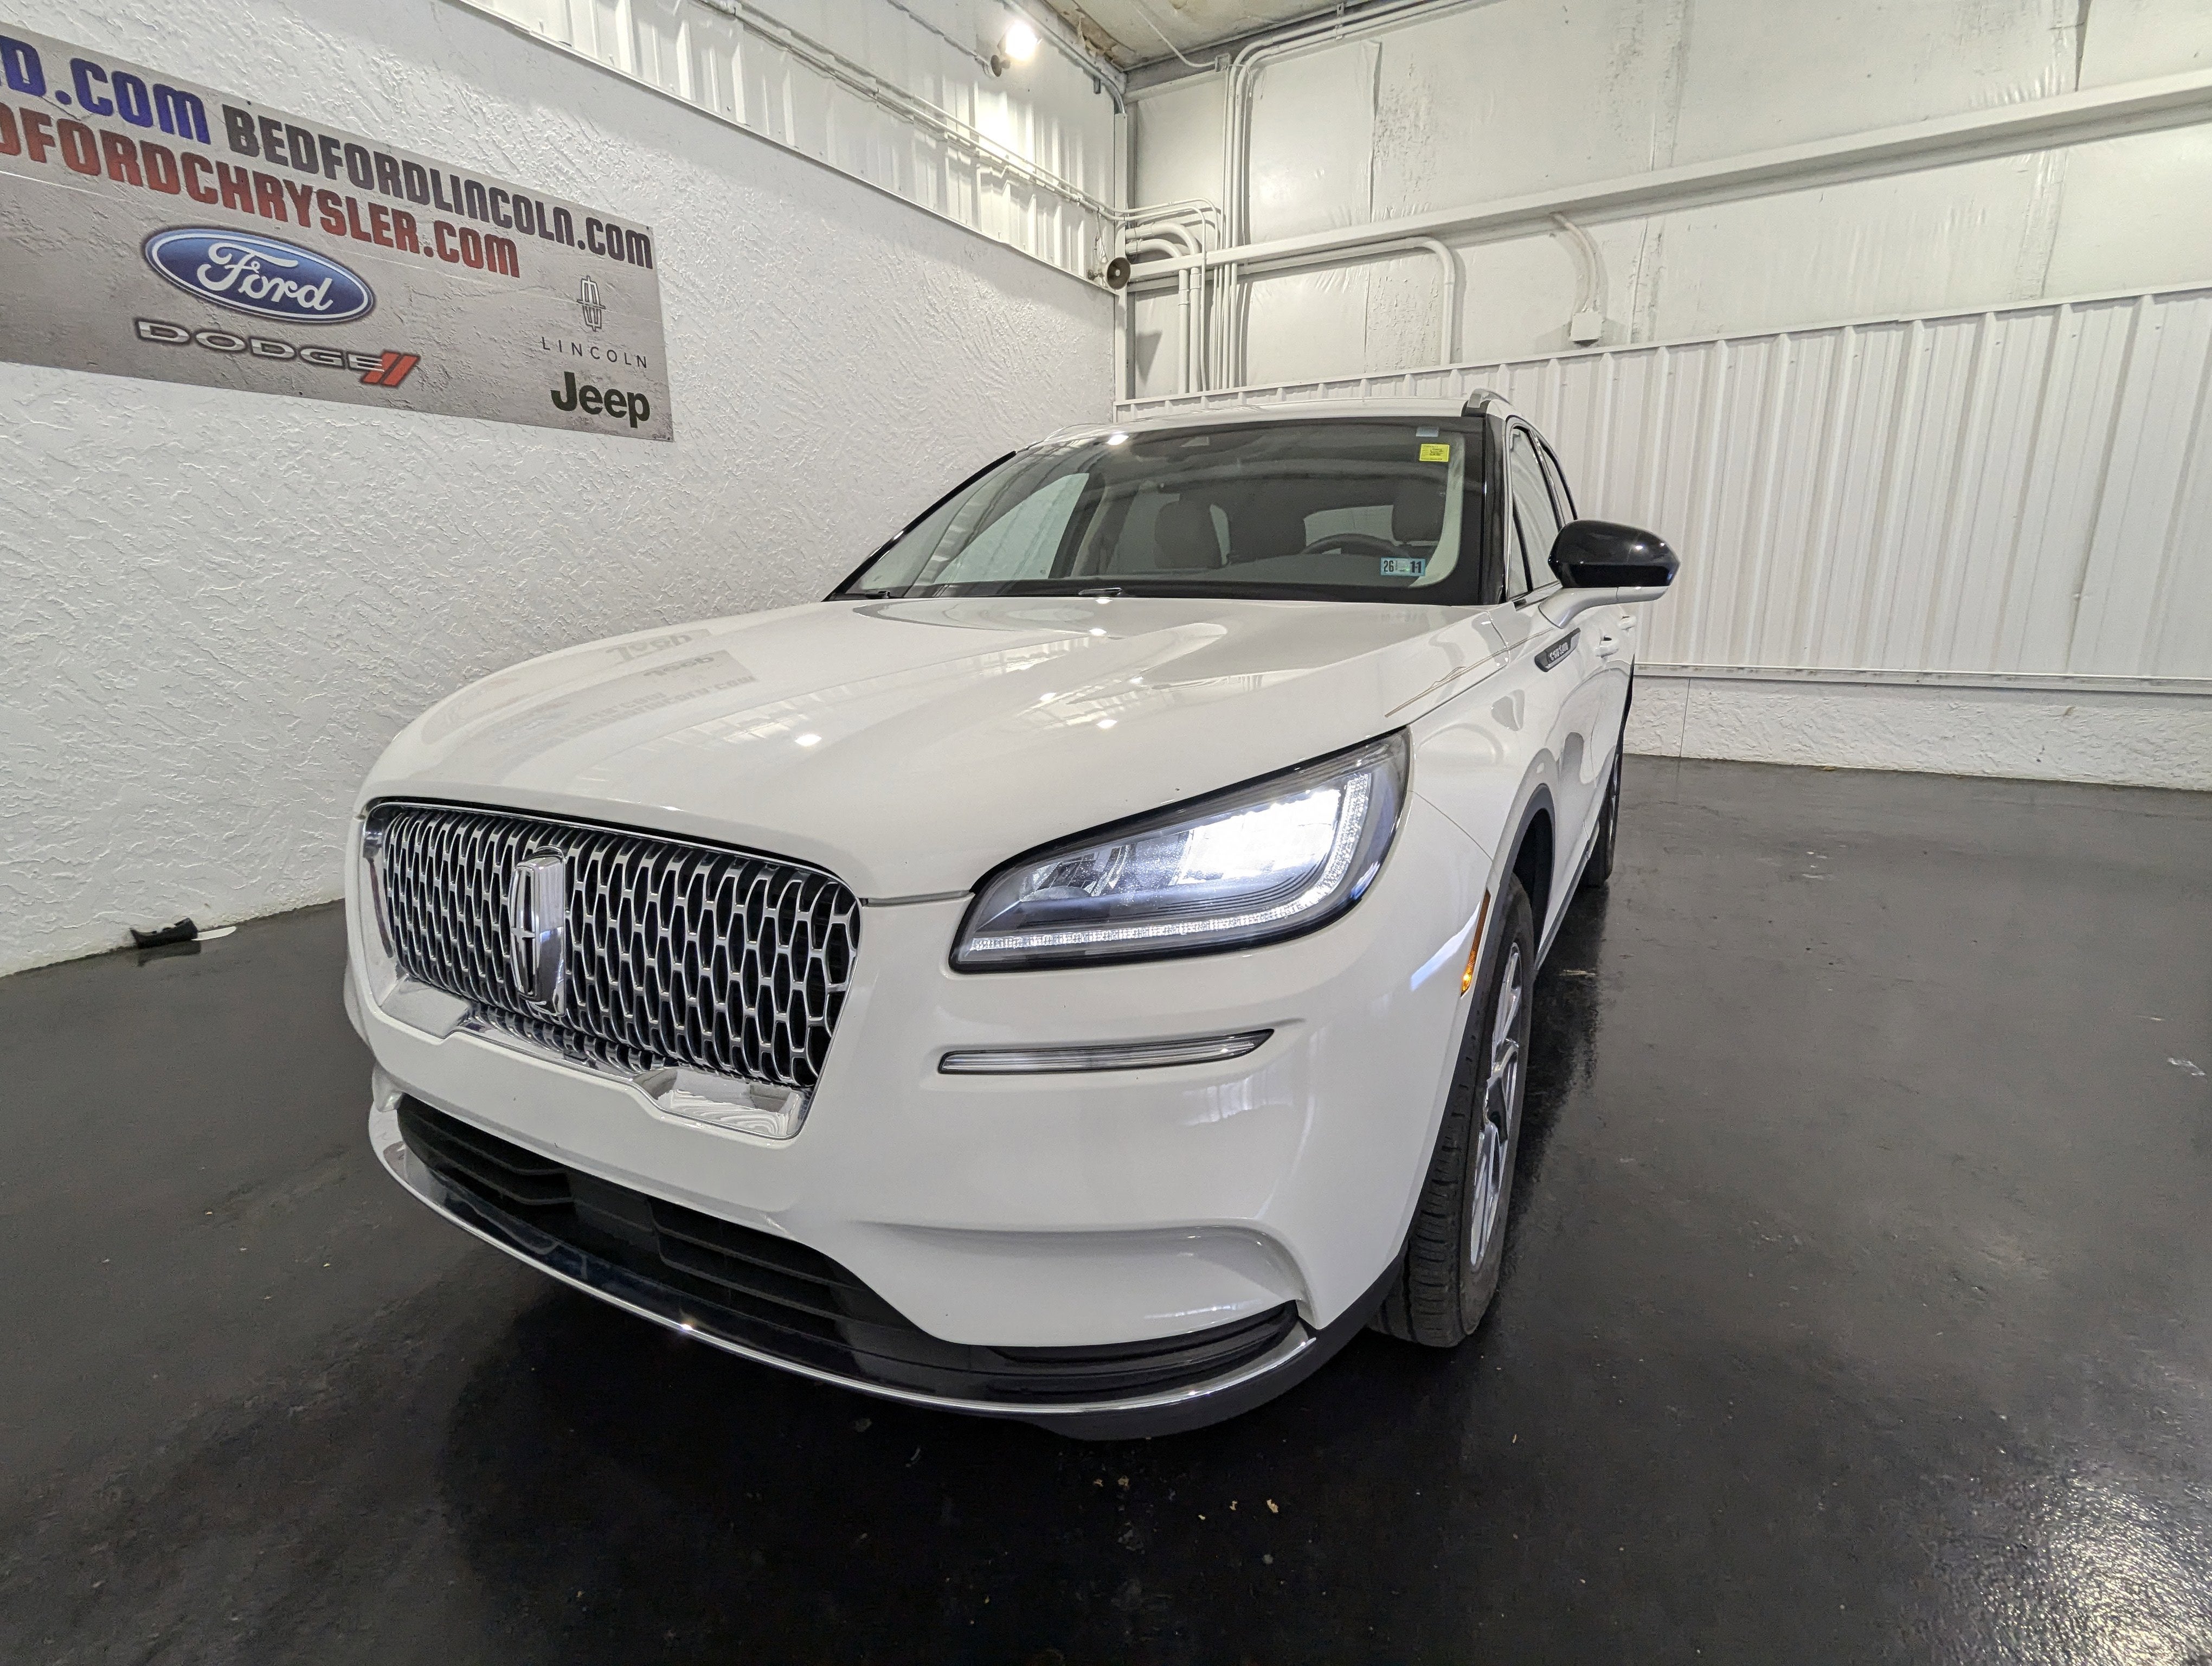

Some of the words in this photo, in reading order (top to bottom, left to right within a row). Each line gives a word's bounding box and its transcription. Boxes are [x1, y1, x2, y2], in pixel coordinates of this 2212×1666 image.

[0, 34, 211, 145] D.COM
[222, 103, 653, 270] BEDFORDLINCOLN.COM
[197, 242, 333, 311] Ford
[137, 320, 384, 373] DODGE
[542, 336, 647, 369] LINCOLN
[550, 371, 651, 428] Jeep
[1384, 560, 1394, 572] 26
[1410, 561, 1422, 573] 11
